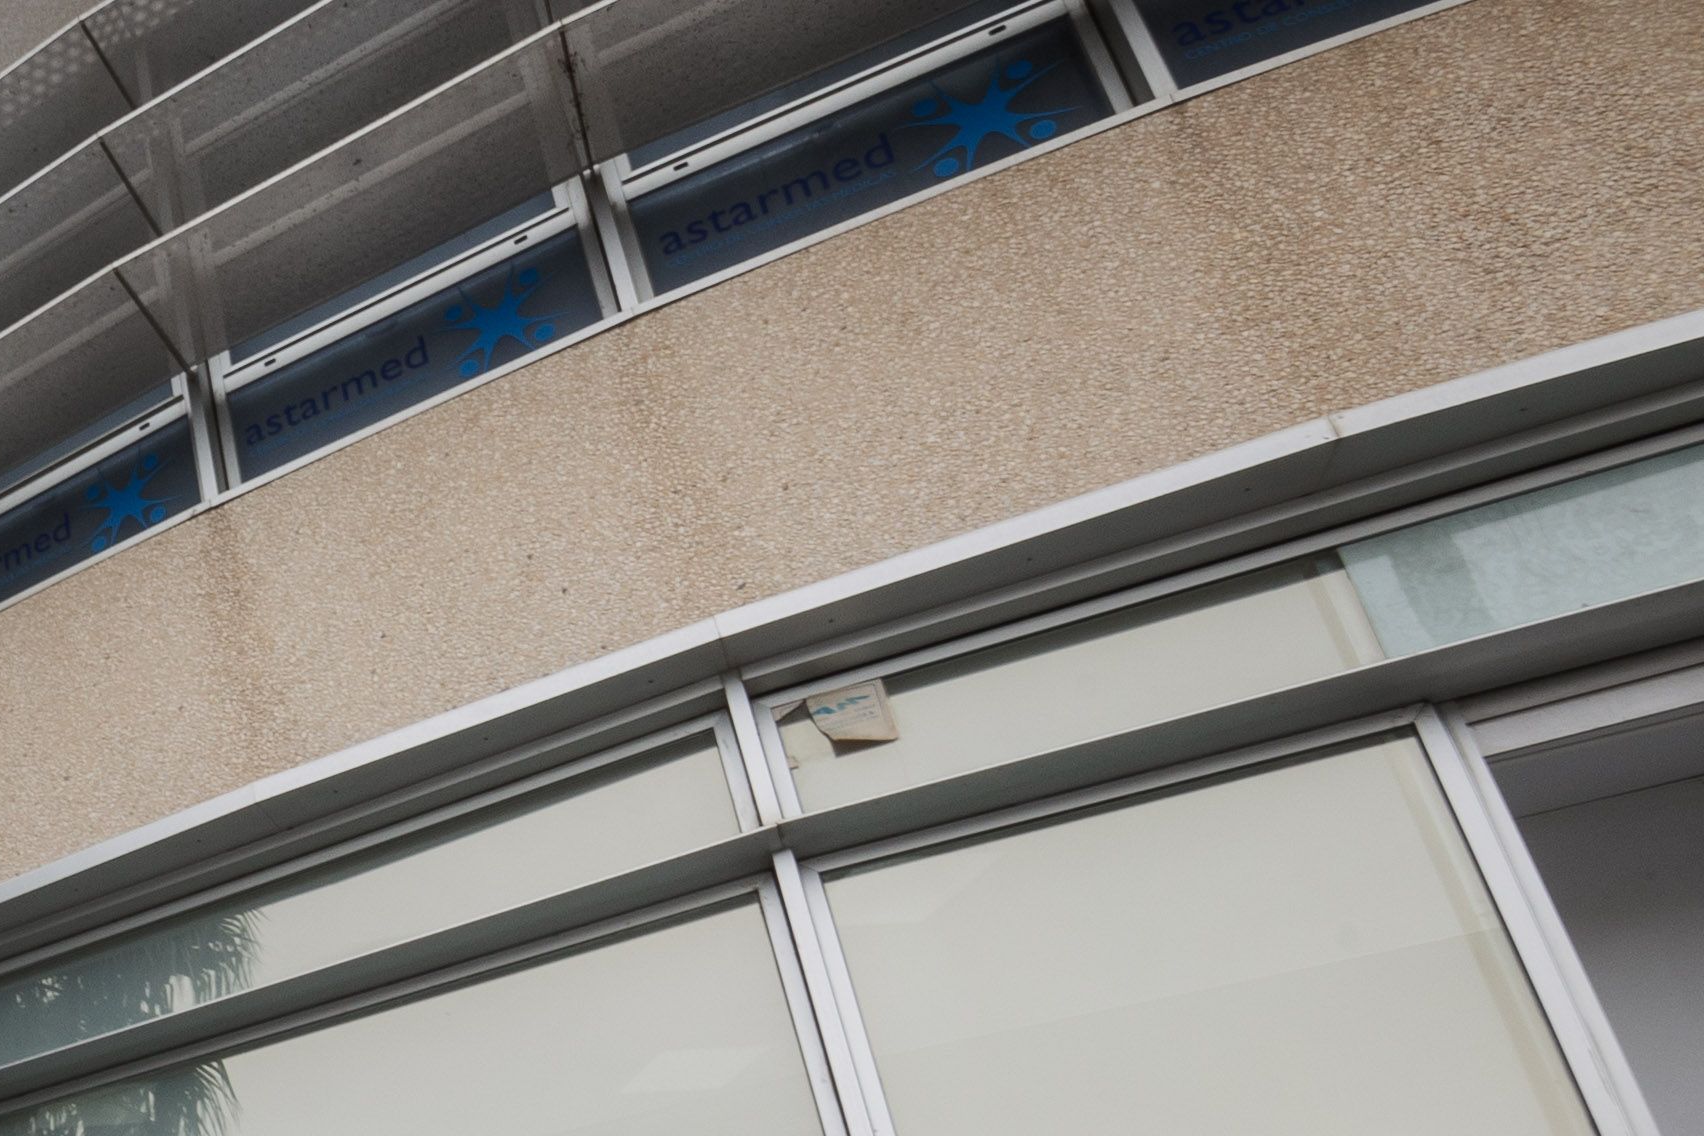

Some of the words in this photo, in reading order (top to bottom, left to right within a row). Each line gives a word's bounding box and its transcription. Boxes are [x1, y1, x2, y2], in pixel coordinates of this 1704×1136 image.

[1171, 0, 1307, 49] asta
[660, 133, 895, 256] astarmed
[245, 334, 429, 446] astarmed
